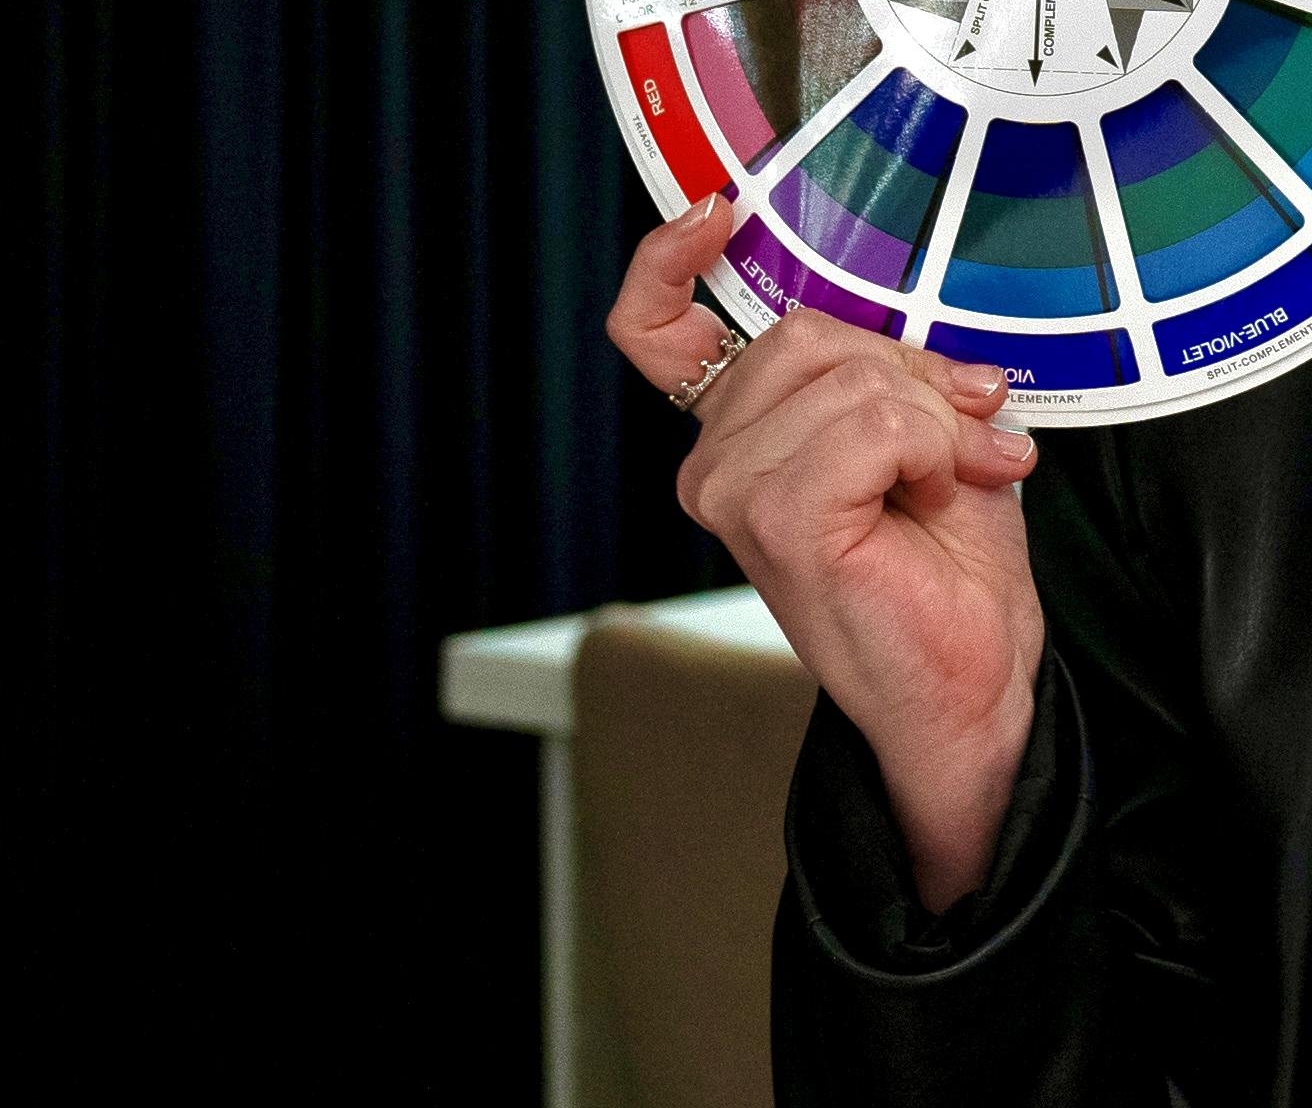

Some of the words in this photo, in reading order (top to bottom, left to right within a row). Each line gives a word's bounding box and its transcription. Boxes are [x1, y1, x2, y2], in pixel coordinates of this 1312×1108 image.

[971, 3, 987, 35] SPLIT
[644, 79, 664, 116] RED
[632, 115, 657, 159] TRIADIC
[740, 256, 805, 312] D-VIOLET
[1182, 307, 1288, 364] BLUE-VIOLET
